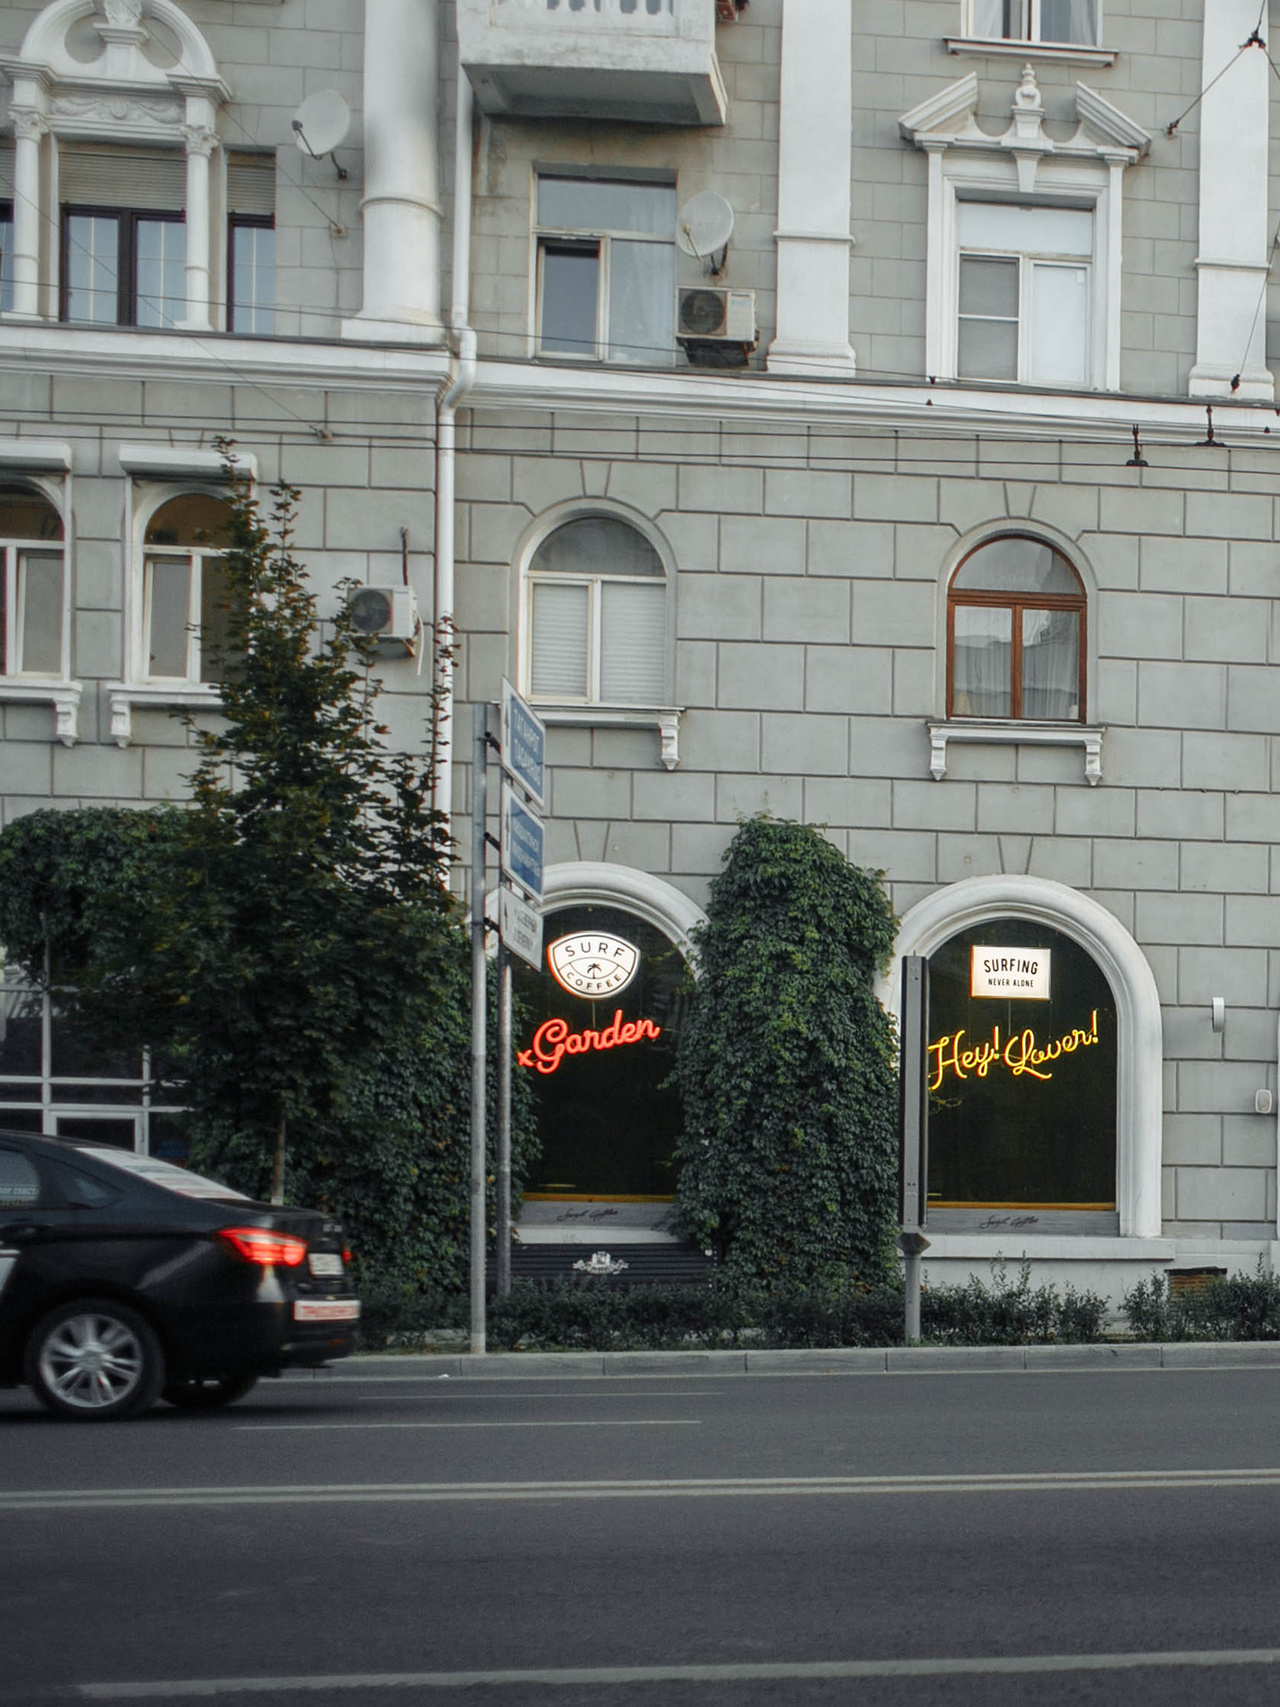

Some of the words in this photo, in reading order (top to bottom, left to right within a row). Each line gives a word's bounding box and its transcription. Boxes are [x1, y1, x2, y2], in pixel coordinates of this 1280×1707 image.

[565, 942, 625, 957] SURF
[983, 958, 1039, 975] SURFING
[566, 972, 622, 990] COFFEE
[988, 978, 1010, 987] NEVER
[1013, 979, 1034, 988] ALONE
[532, 1009, 661, 1074] Garden
[927, 1026, 1000, 1091] Hey!
[1004, 1009, 1099, 1079] Lover!
